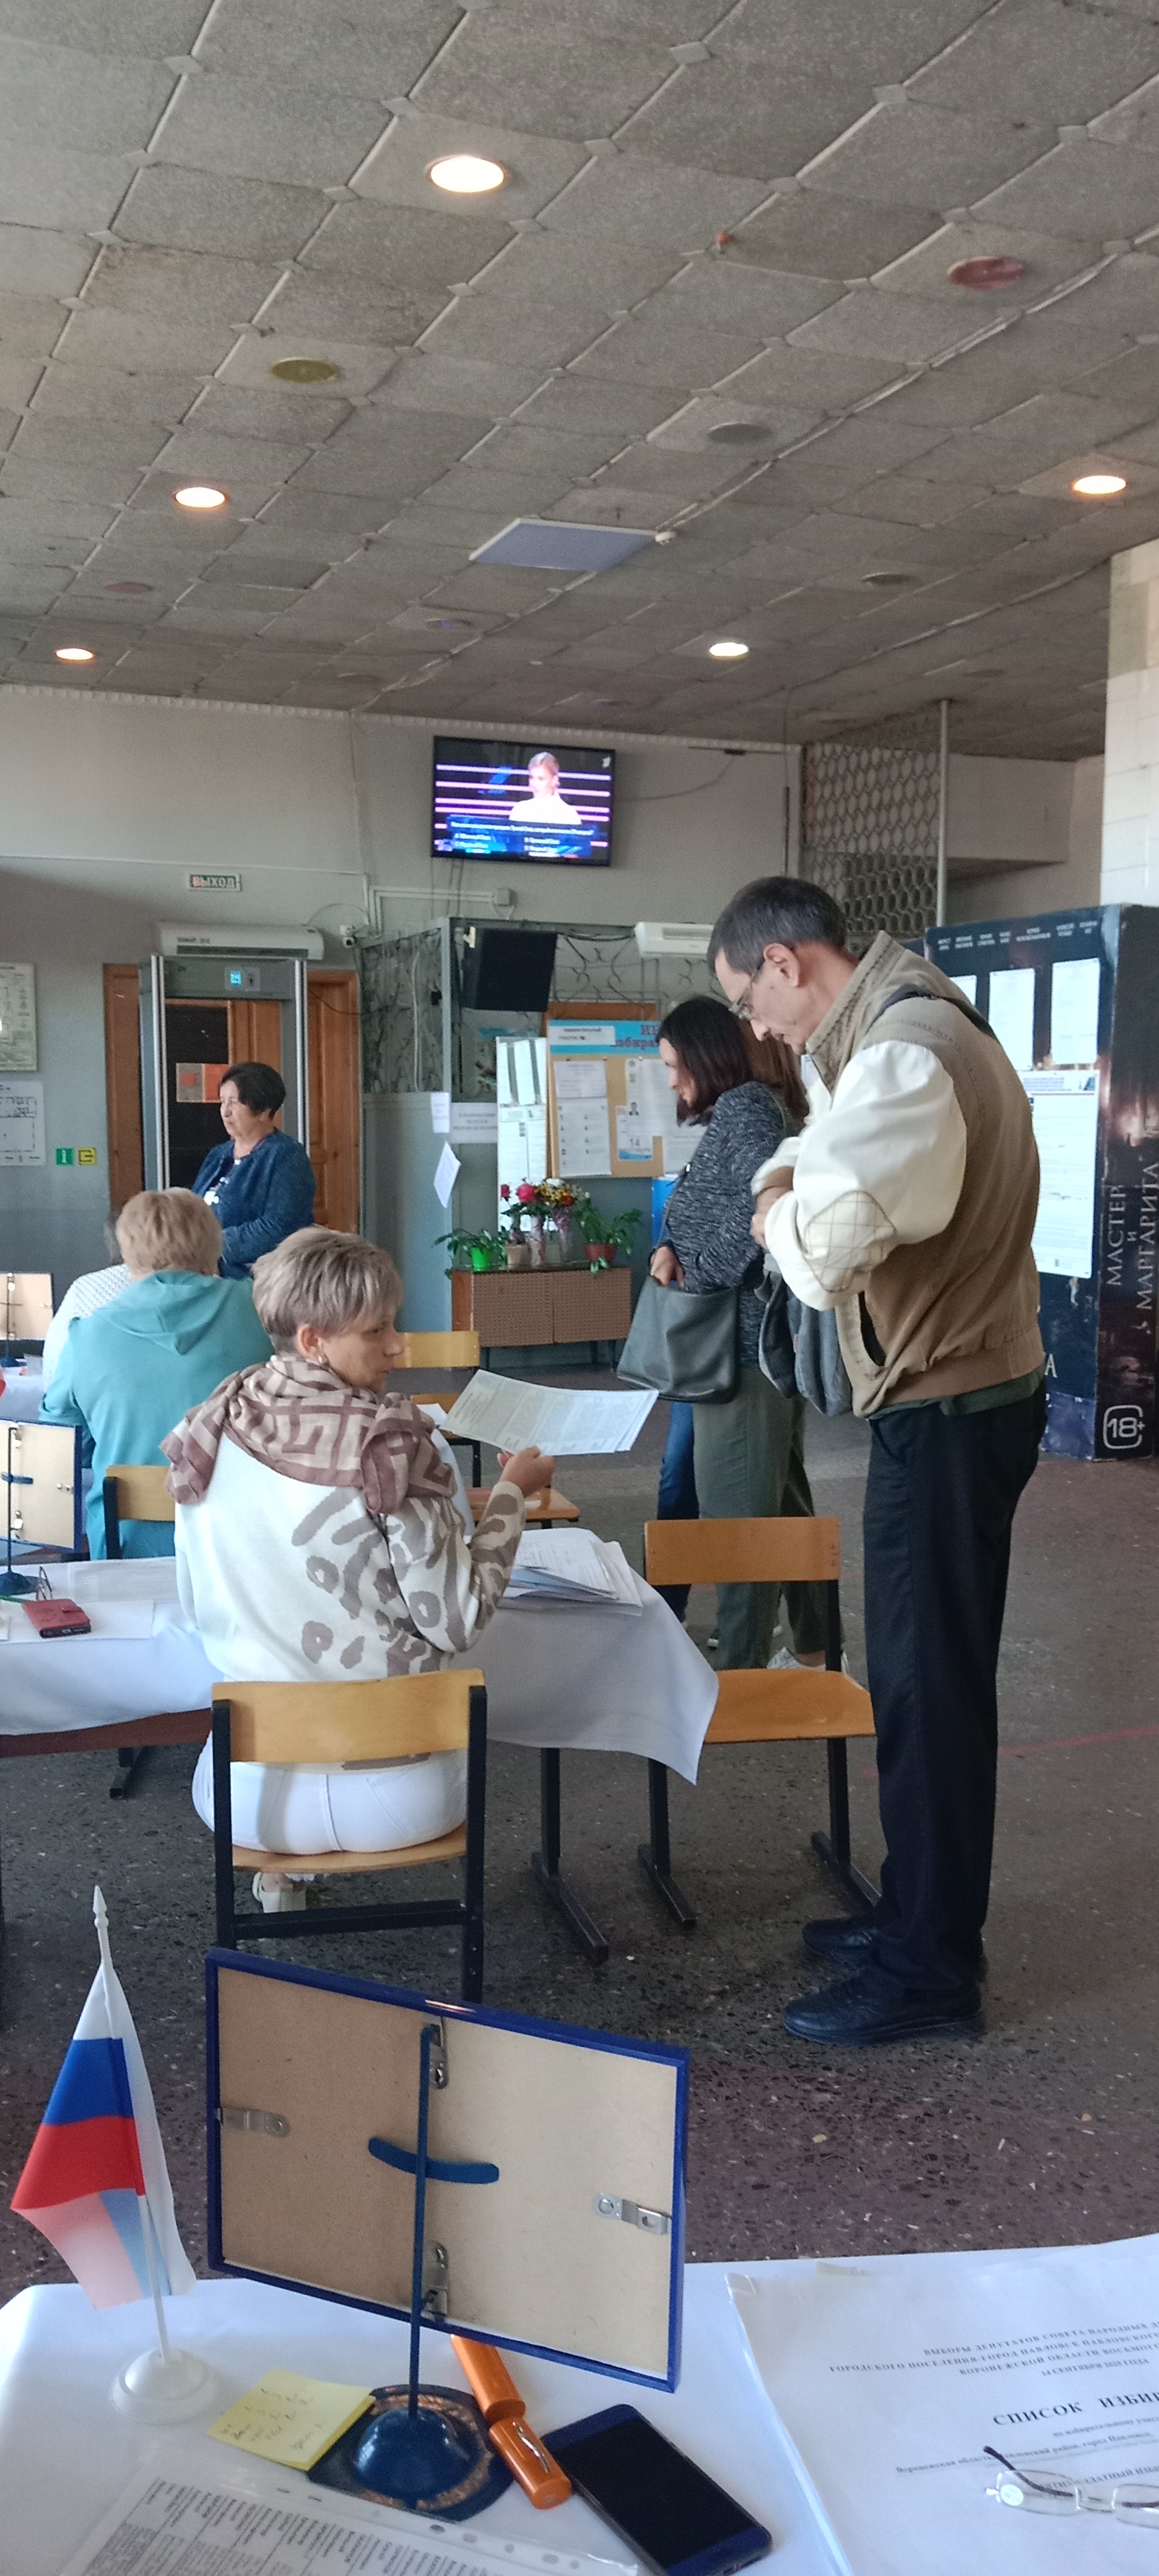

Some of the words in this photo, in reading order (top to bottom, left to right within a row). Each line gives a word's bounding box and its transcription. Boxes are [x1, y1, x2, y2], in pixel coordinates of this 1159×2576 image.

[191, 875, 235, 889] ВЫХОД
[1106, 1184, 1126, 1286] МАСТЕР
[1135, 1162, 1159, 1310] МАРГАРИТА
[1106, 1417, 1145, 1438] 18+
[924, 2346, 971, 2356] ВЫБОРЫ
[976, 2336, 1040, 2351] ДЕПУТАТОВ
[1043, 2330, 1085, 2339] СОВЕТА
[1088, 2323, 1148, 2334] НАРОДНЫХ
[830, 2363, 905, 2372] ГОРОДСКОГО
[1021, 2341, 1079, 2355] ПАВЛОВСК
[959, 2356, 1045, 2375] ВОРОНЕЖСКОЙ
[1048, 2350, 1099, 2361] ОБЛАСТИ
[1053, 2363, 1103, 2375] СЕНТЯБРЯ
[1122, 2357, 1150, 2366] ГОДА
[993, 2401, 1082, 2426] СПИСОК
